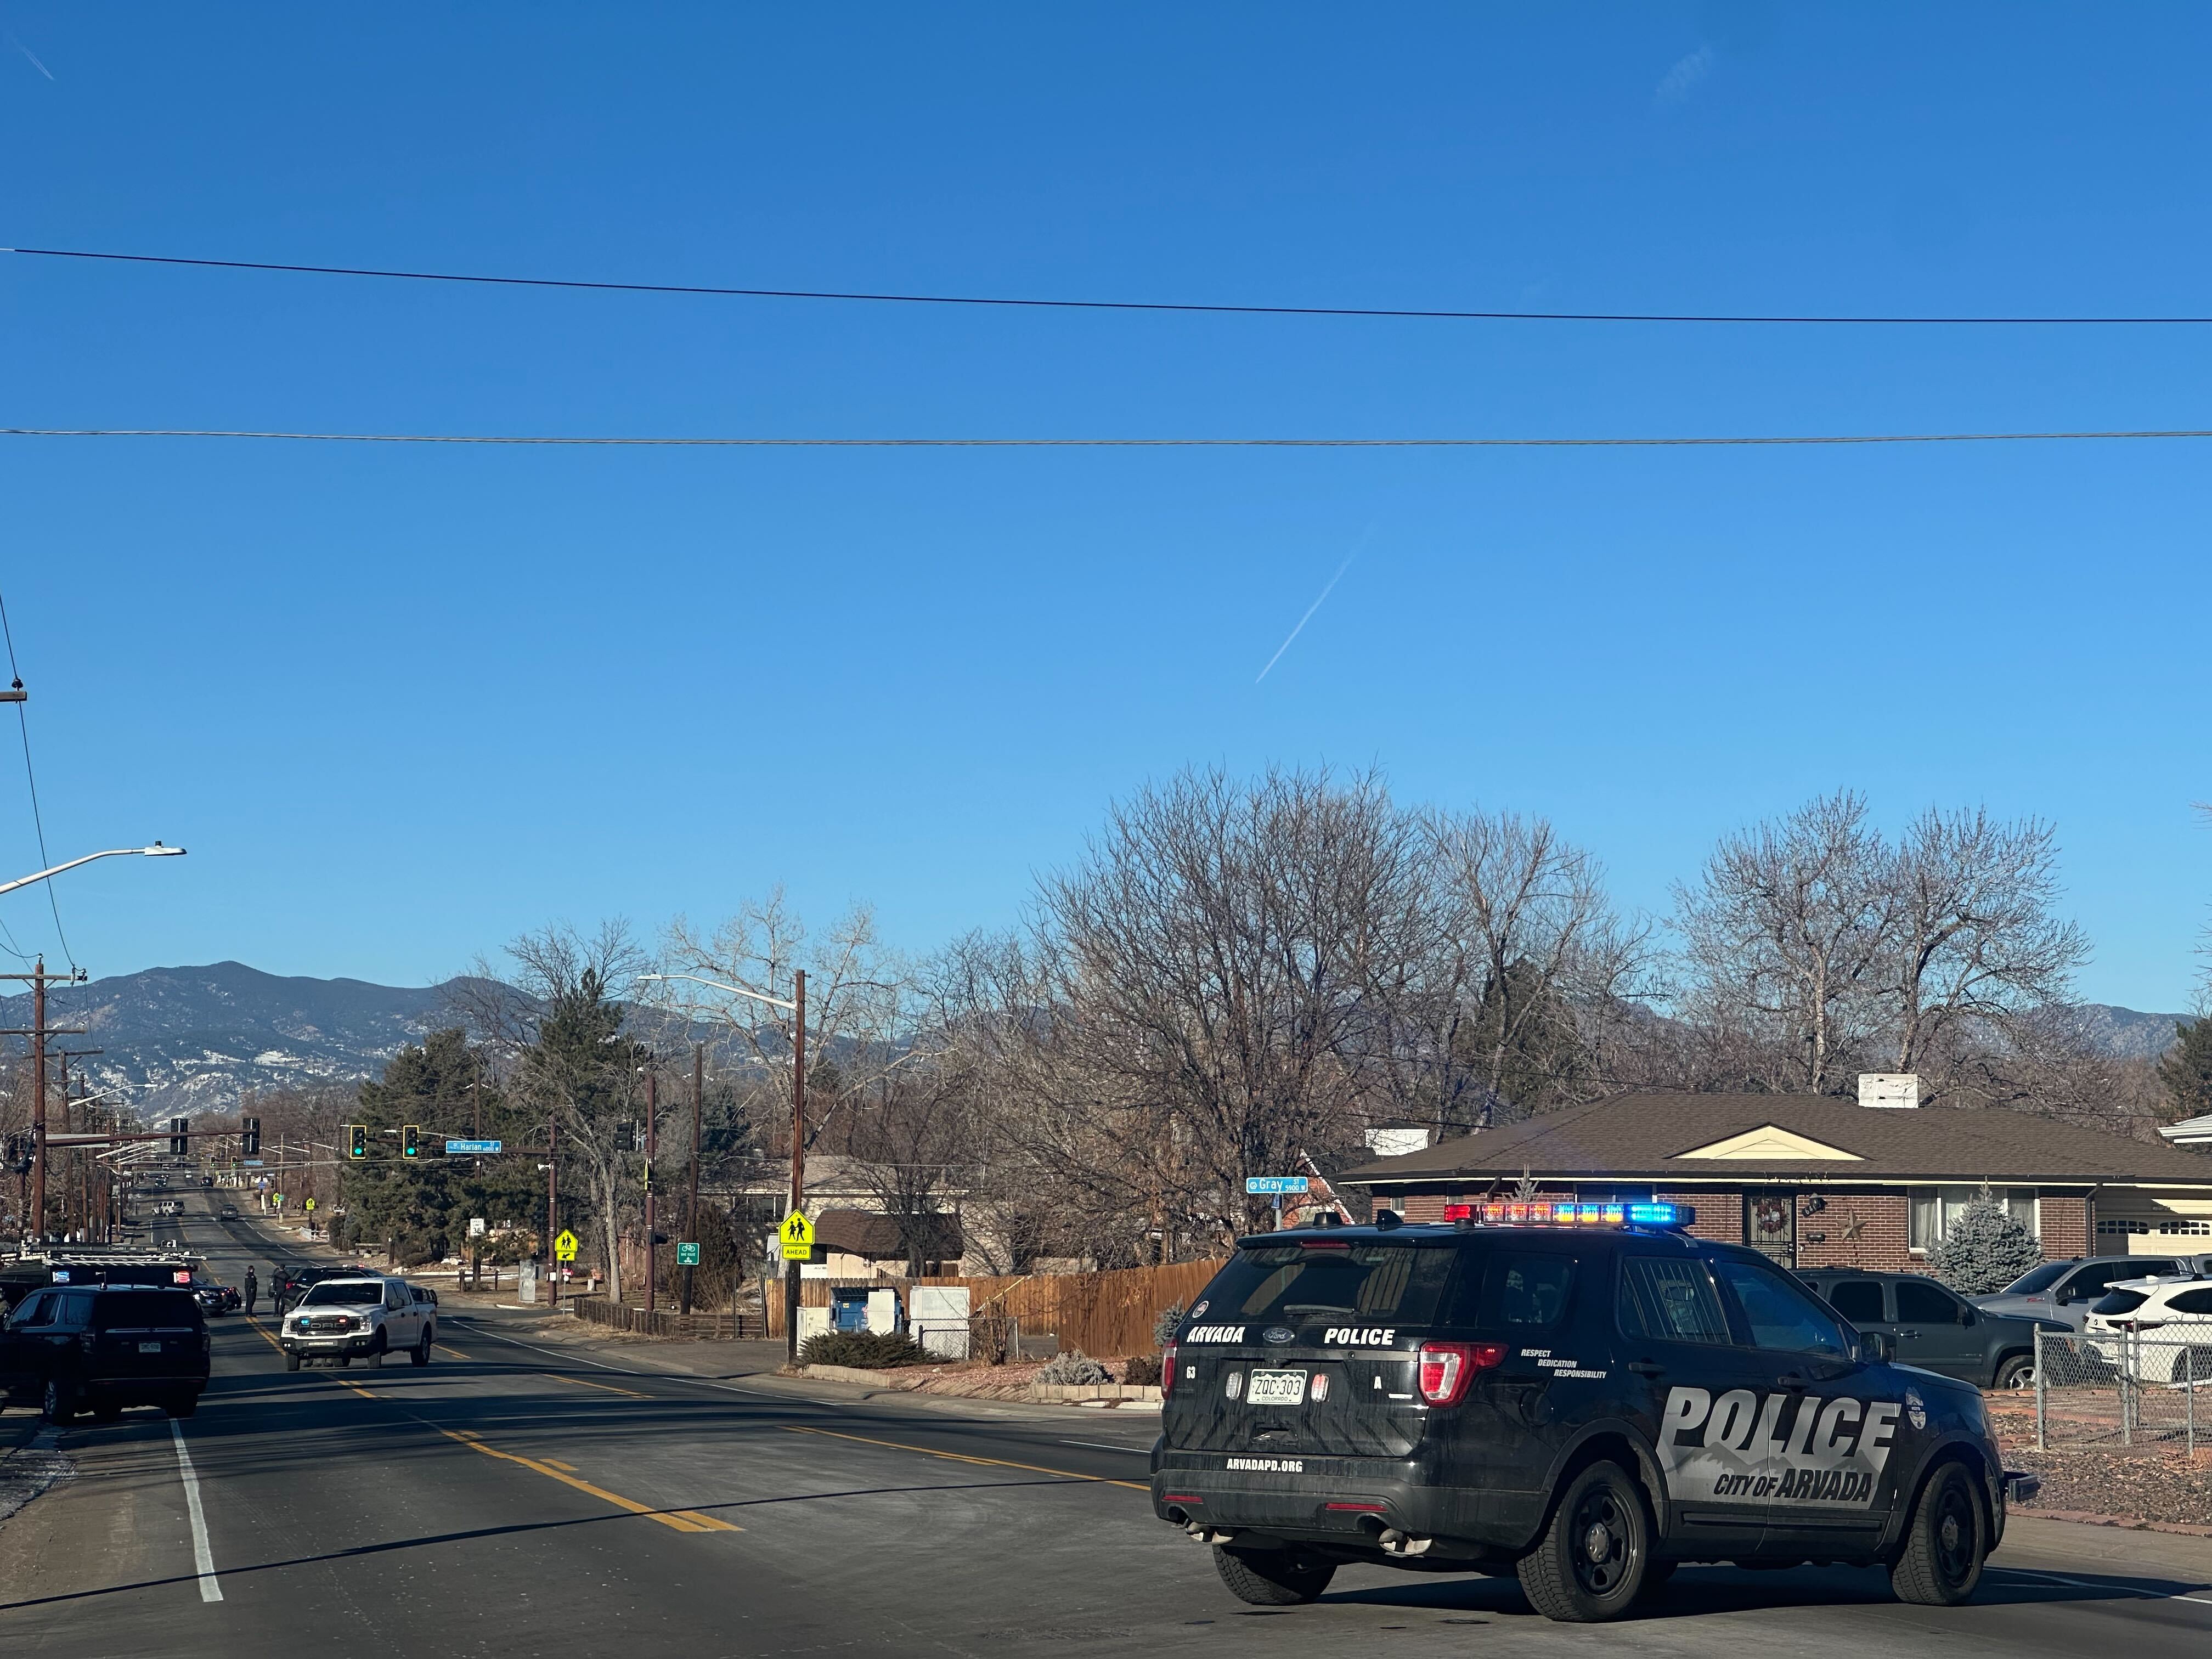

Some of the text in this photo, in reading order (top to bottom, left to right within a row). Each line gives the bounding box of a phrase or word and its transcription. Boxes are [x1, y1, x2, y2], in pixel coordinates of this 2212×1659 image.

[1259, 1178, 1283, 1192] Gray
[1186, 1326, 1245, 1343] ARVADA
[1268, 1330, 1286, 1339] Ford
[1324, 1328, 1396, 1346] POLICE
[1521, 1349, 1551, 1357] RESPECT
[1537, 1359, 1577, 1368] DEDICATION
[1187, 1366, 1195, 1379] 63
[1554, 1369, 1607, 1379] RESPONSIBILITY
[1374, 1376, 1382, 1389] A
[1656, 1386, 1902, 1460] POLICE
[1227, 1458, 1303, 1472] ARVADAPD.ORG
[1713, 1468, 1872, 1502] CITY OF ARVADA
